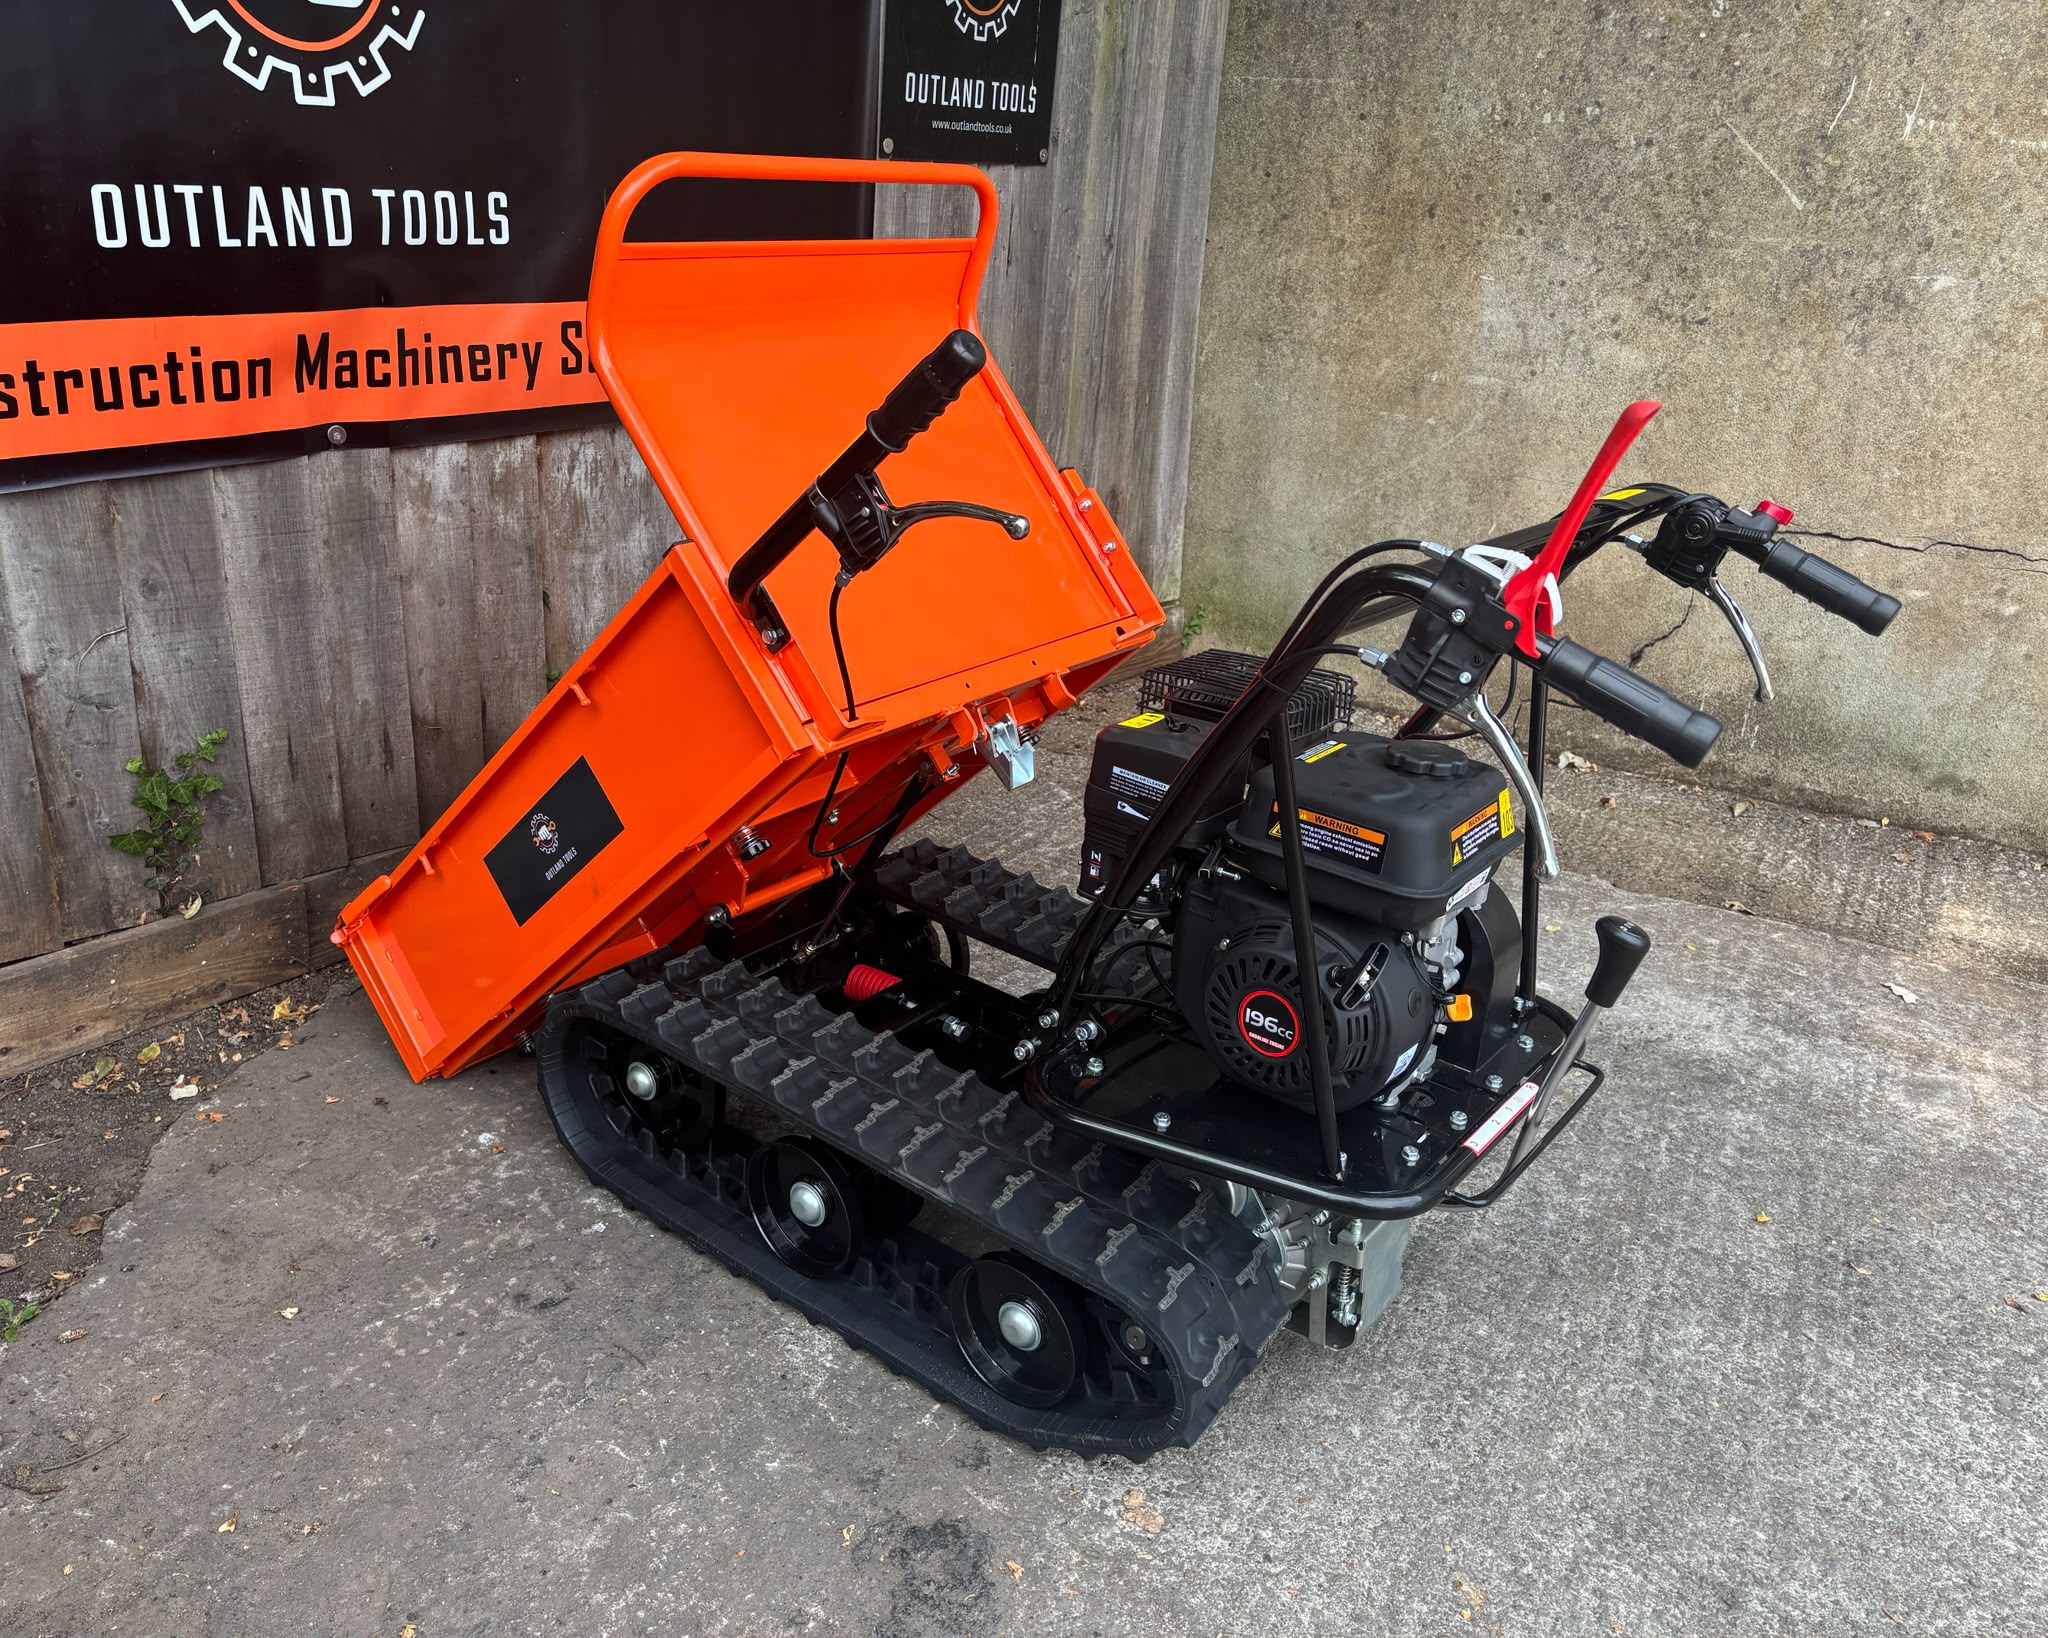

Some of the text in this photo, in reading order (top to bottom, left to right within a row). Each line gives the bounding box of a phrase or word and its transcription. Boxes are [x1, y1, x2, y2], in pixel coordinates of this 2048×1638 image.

[905, 72, 1037, 114] OUTLAND TOOLS
[931, 119, 1013, 134] www.outlandtools.co.uk
[90, 183, 510, 248] OUTLAND TOOLS
[295, 328, 543, 393] Machinery
[1314, 814, 1359, 836] WARNING
[545, 846, 577, 880] OUTLAND TOOLS
[1245, 1007, 1294, 1041] 196cc
